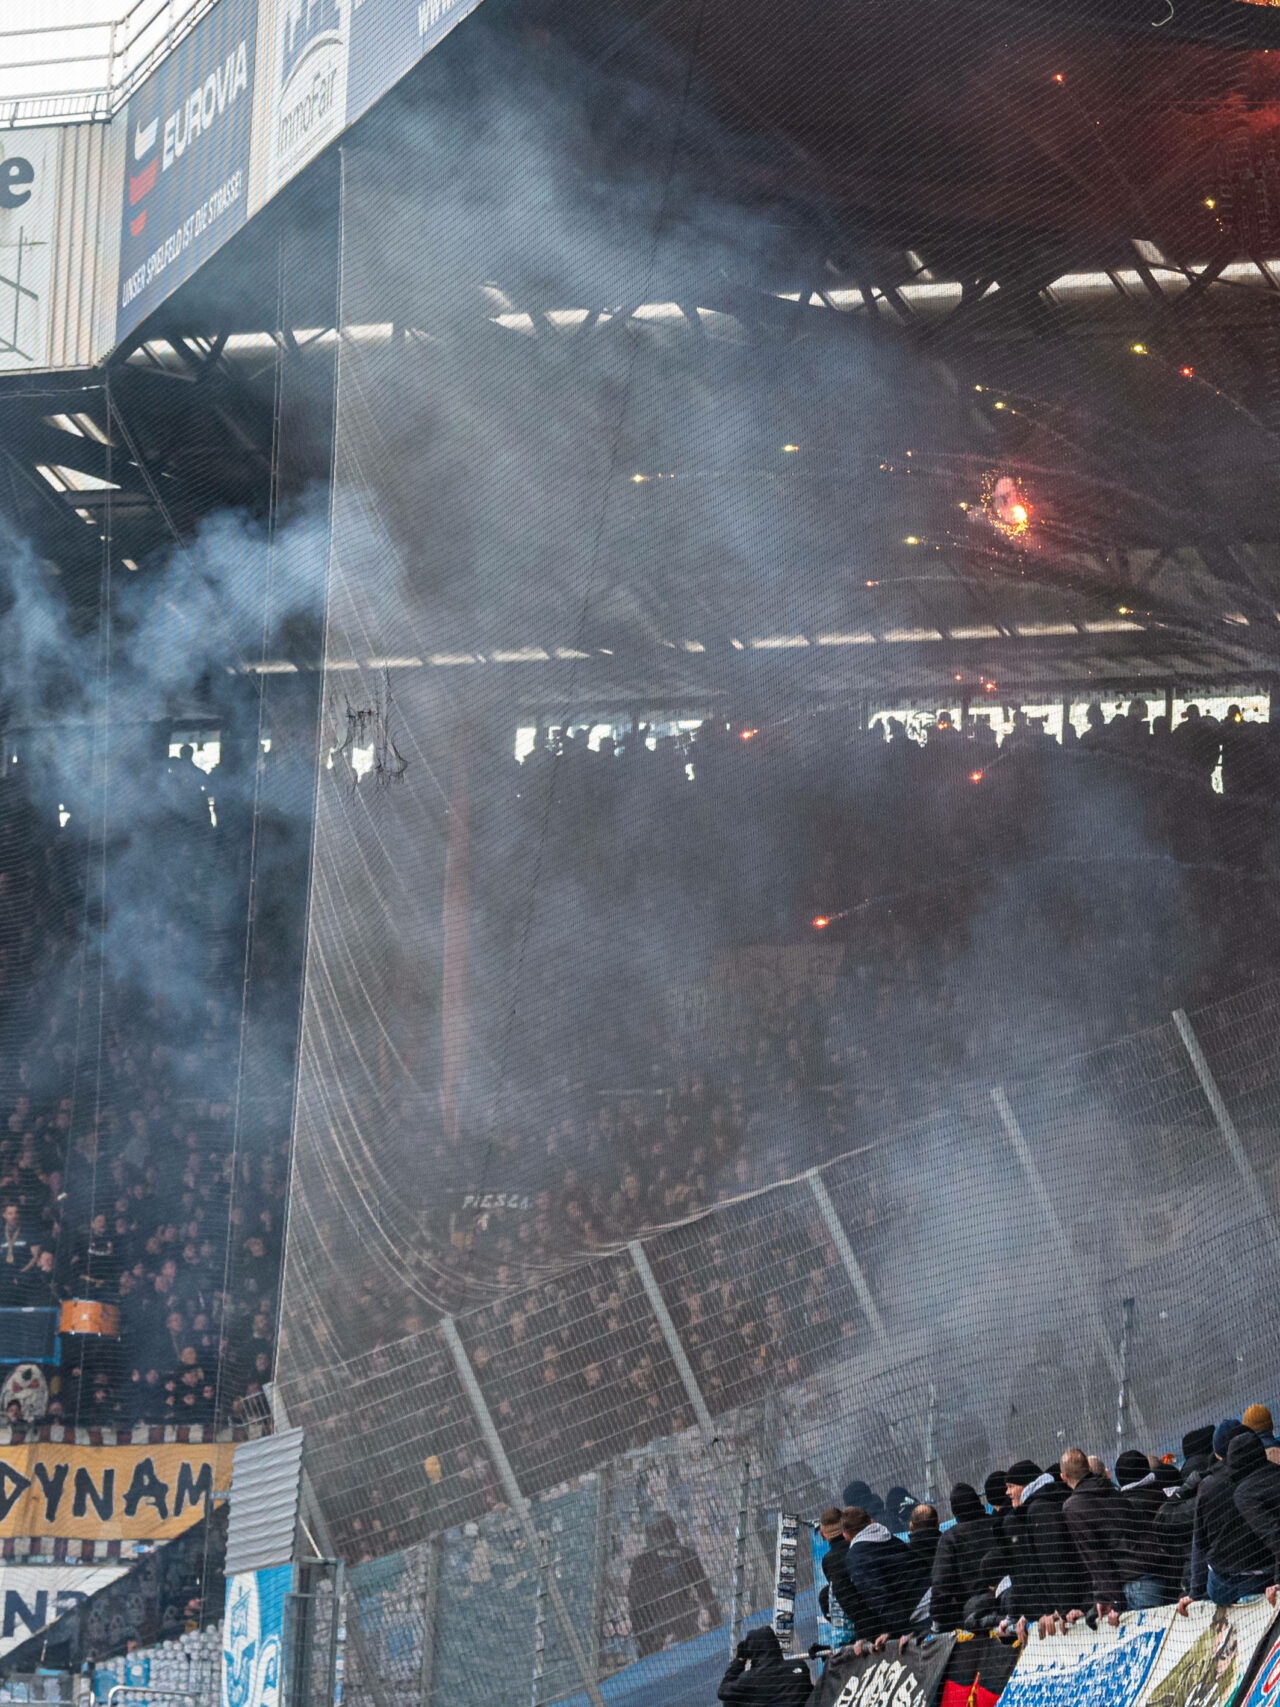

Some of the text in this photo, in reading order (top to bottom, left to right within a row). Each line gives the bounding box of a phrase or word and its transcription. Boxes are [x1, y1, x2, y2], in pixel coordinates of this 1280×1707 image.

[162, 40, 248, 172] EUROVIA
[122, 263, 146, 308] UNSER
[146, 229, 182, 285] SPIELFELD
[182, 214, 195, 250] IST
[195, 202, 209, 238] DIE
